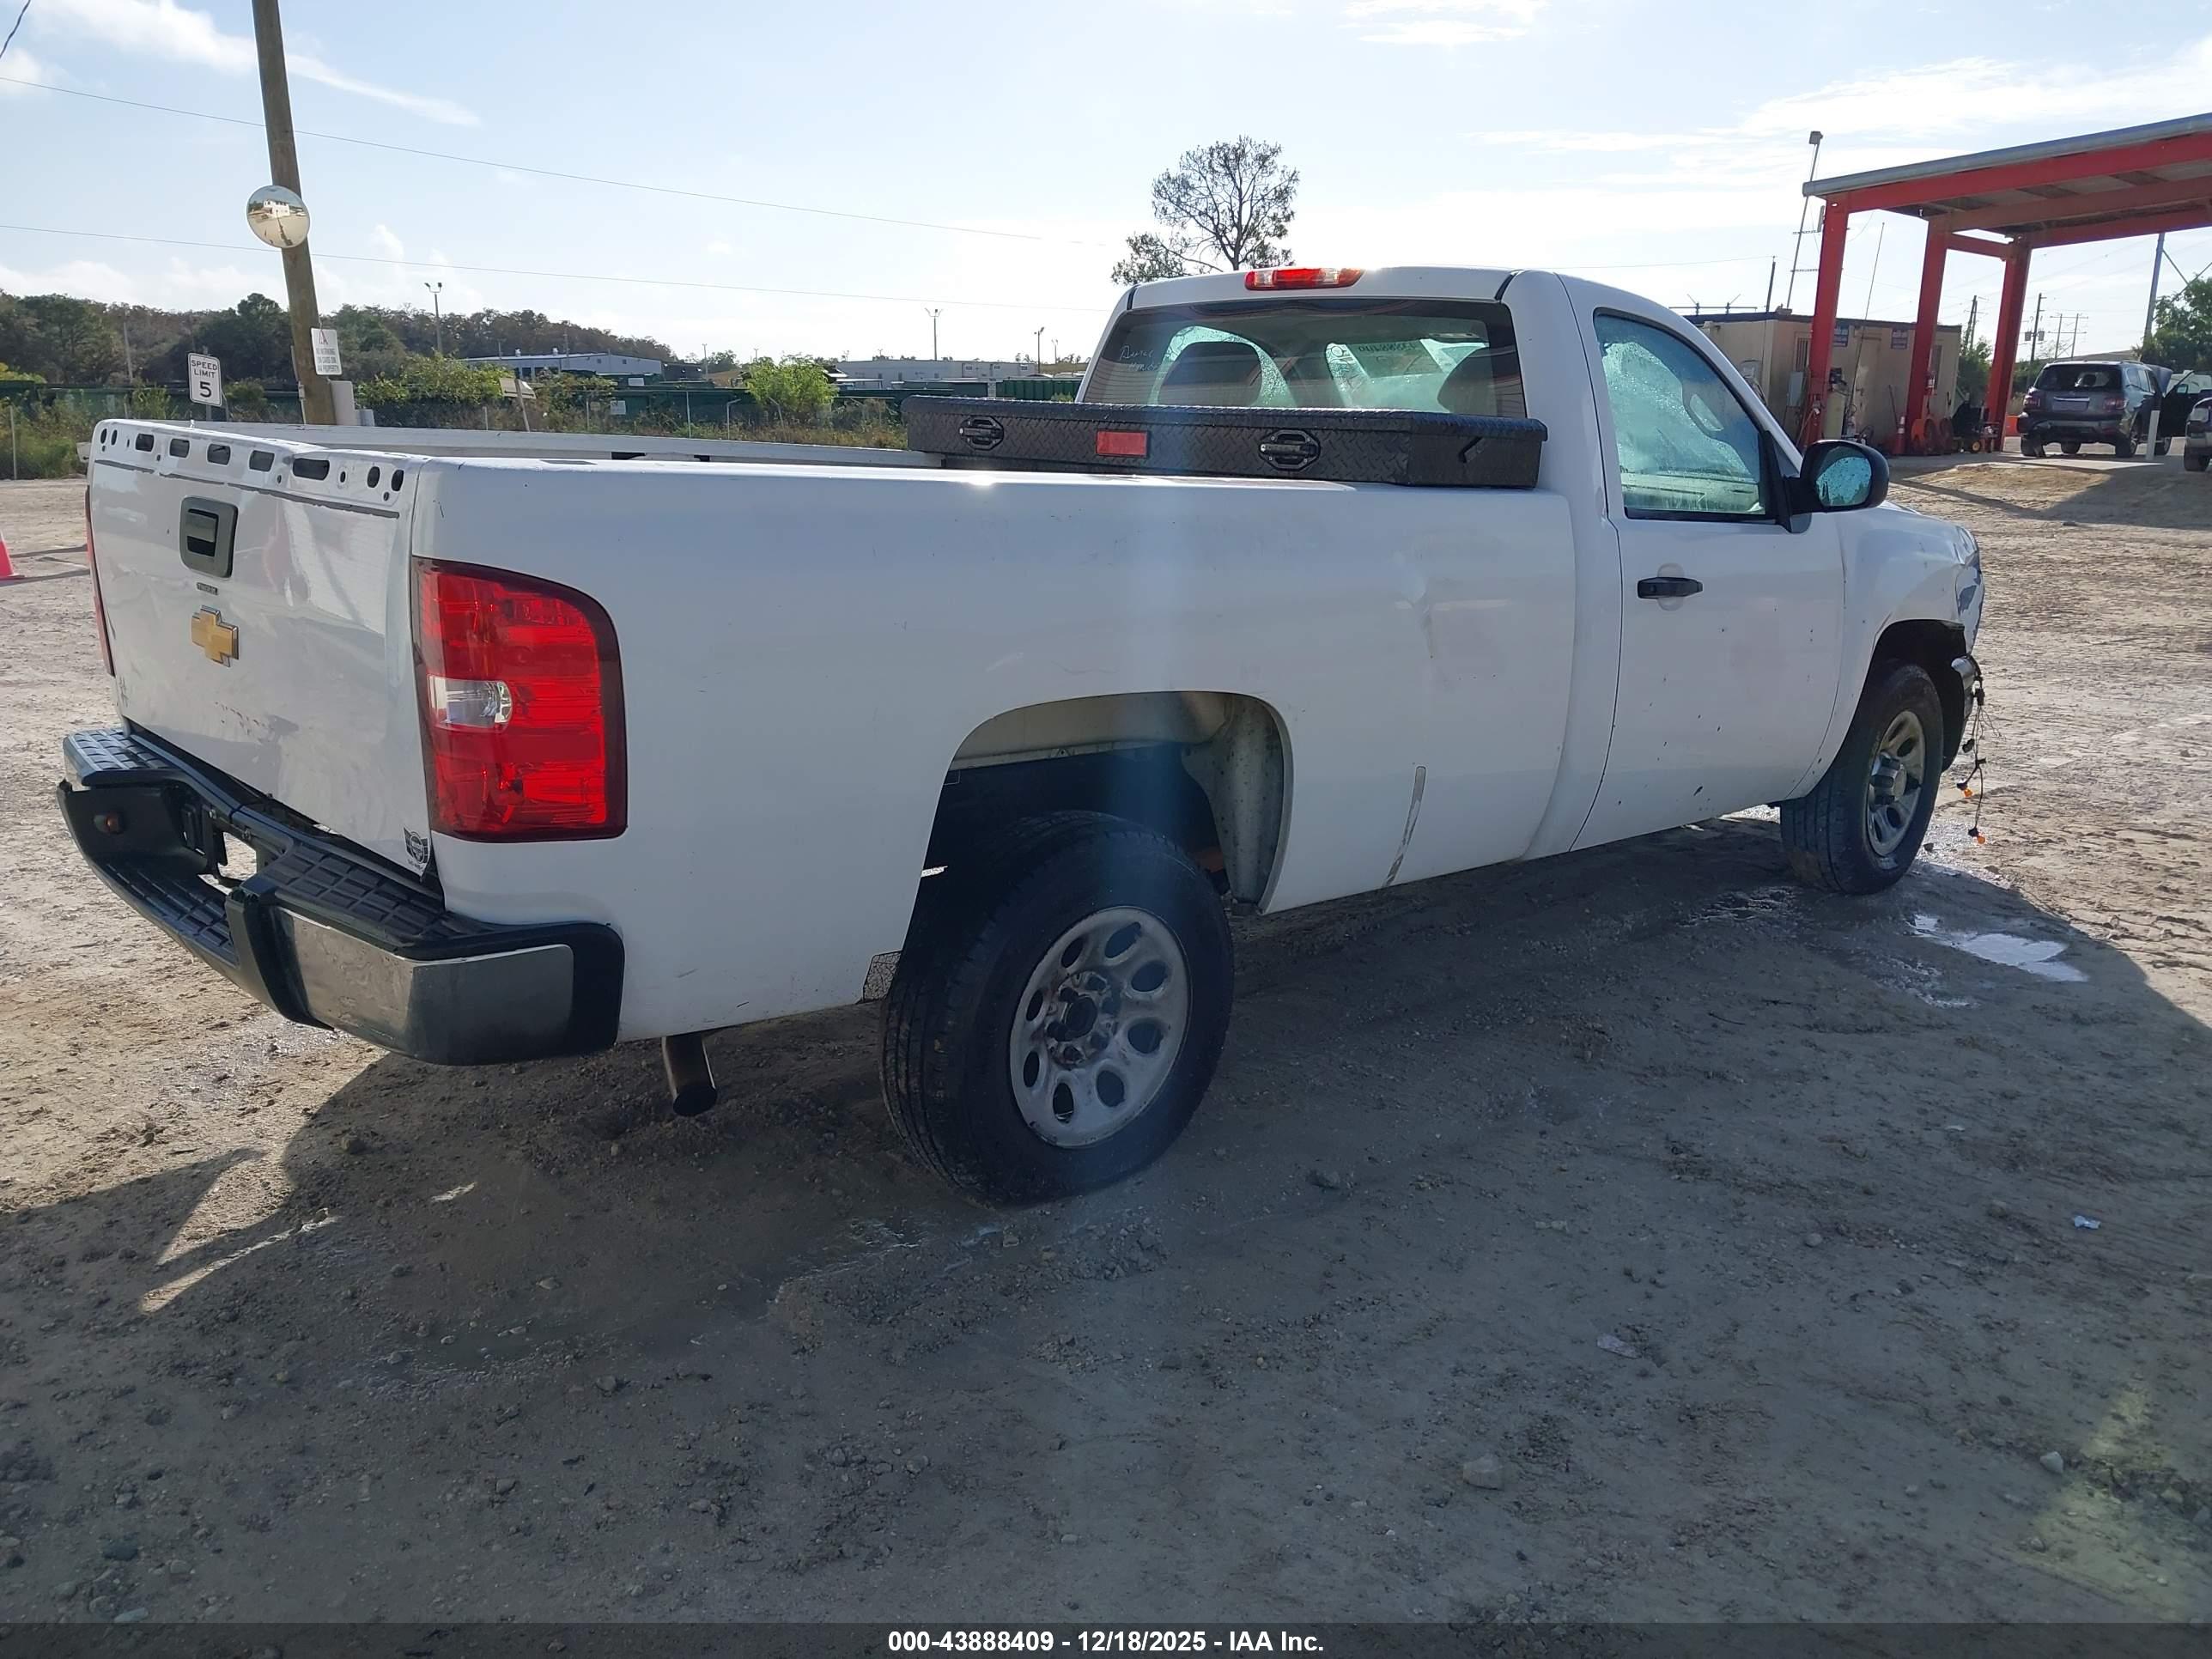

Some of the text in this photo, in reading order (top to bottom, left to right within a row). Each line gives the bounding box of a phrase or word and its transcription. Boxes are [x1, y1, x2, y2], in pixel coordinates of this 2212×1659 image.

[191, 359, 218, 371] SPEED
[194, 368, 216, 379] LIMIT
[199, 380, 212, 398] 5
